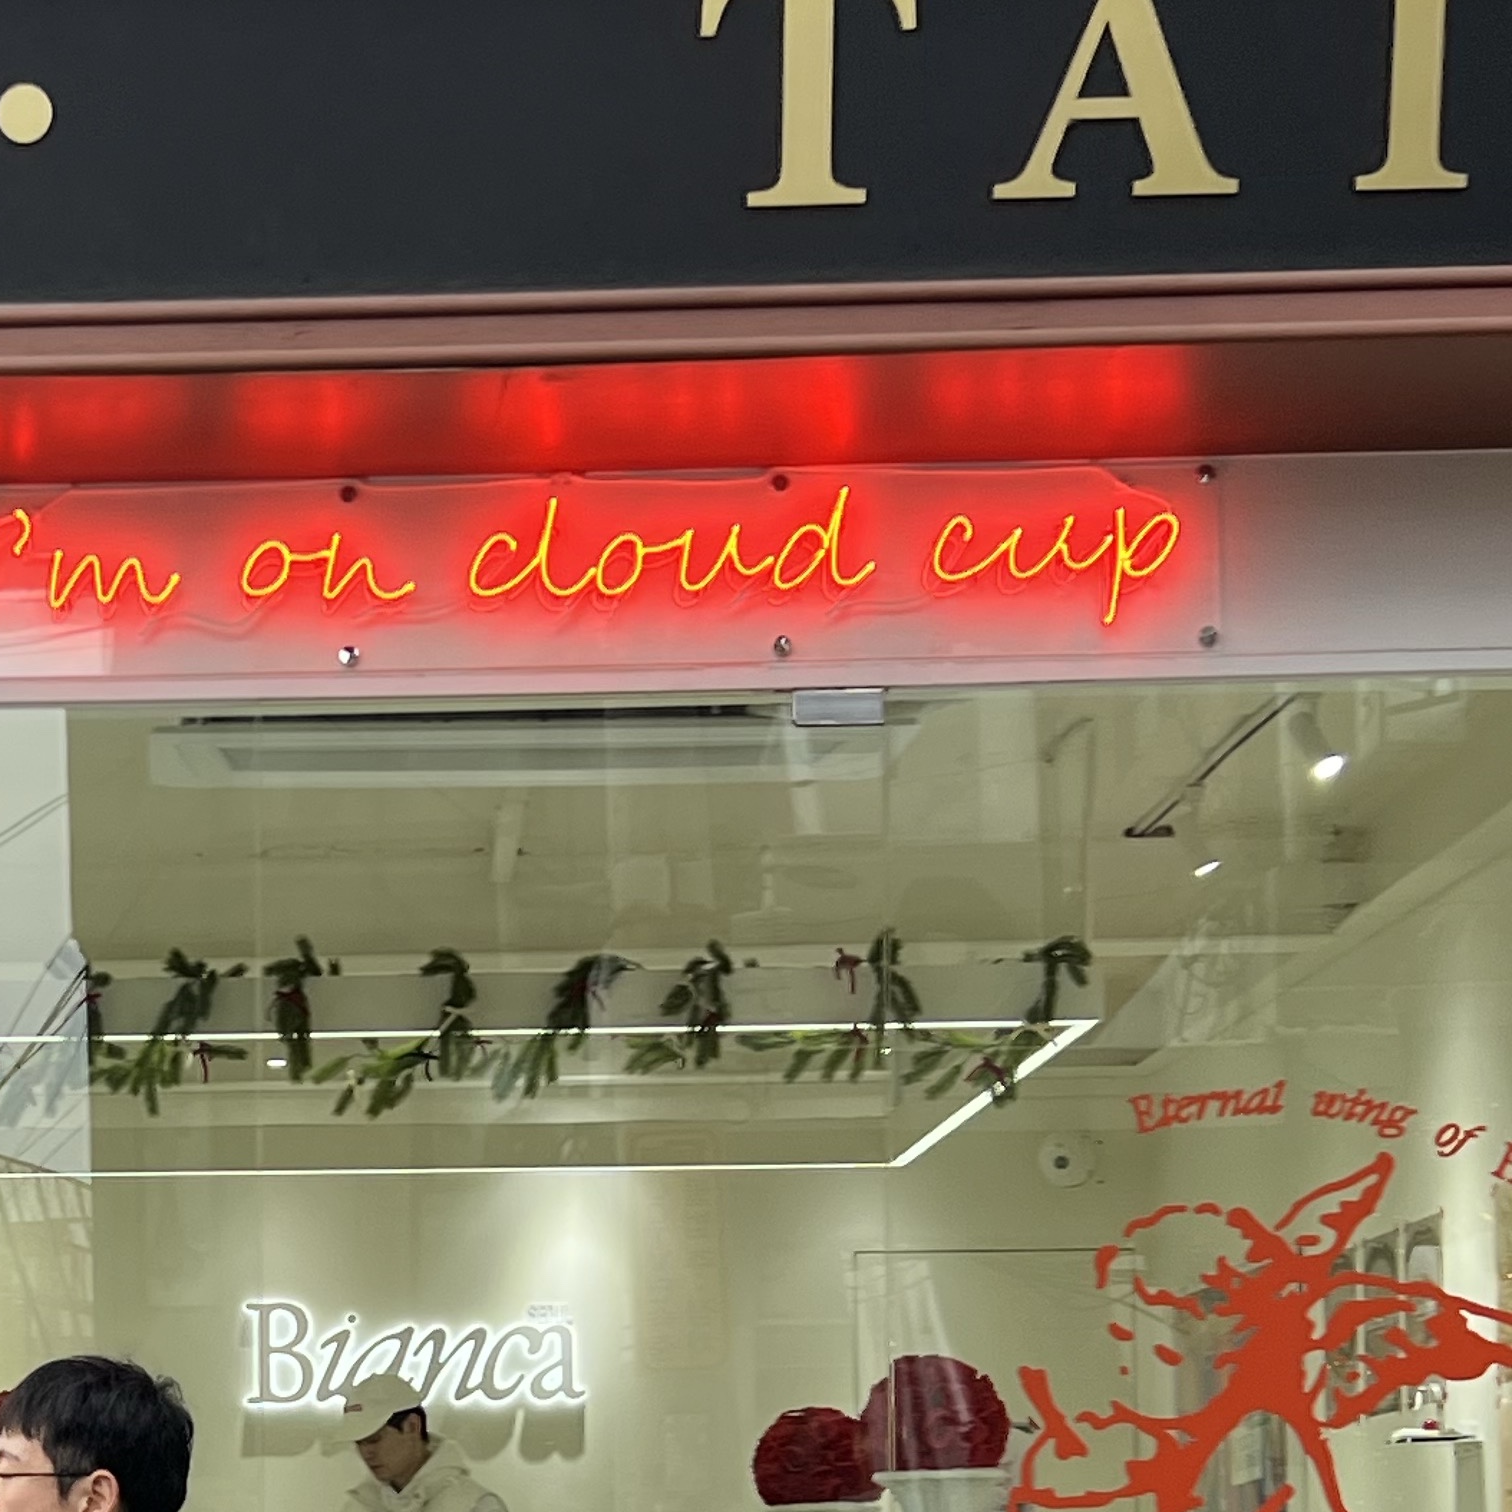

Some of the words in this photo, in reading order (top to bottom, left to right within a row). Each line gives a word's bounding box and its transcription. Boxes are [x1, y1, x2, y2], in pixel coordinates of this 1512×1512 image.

[238, 530, 418, 601] on
[467, 485, 877, 597] cloud
[931, 505, 1180, 626] cup
[1130, 1079, 1287, 1134] Eternal
[1310, 1087, 1418, 1140] wing
[1434, 1122, 1487, 1158] of
[245, 1301, 587, 1404] Bianca
